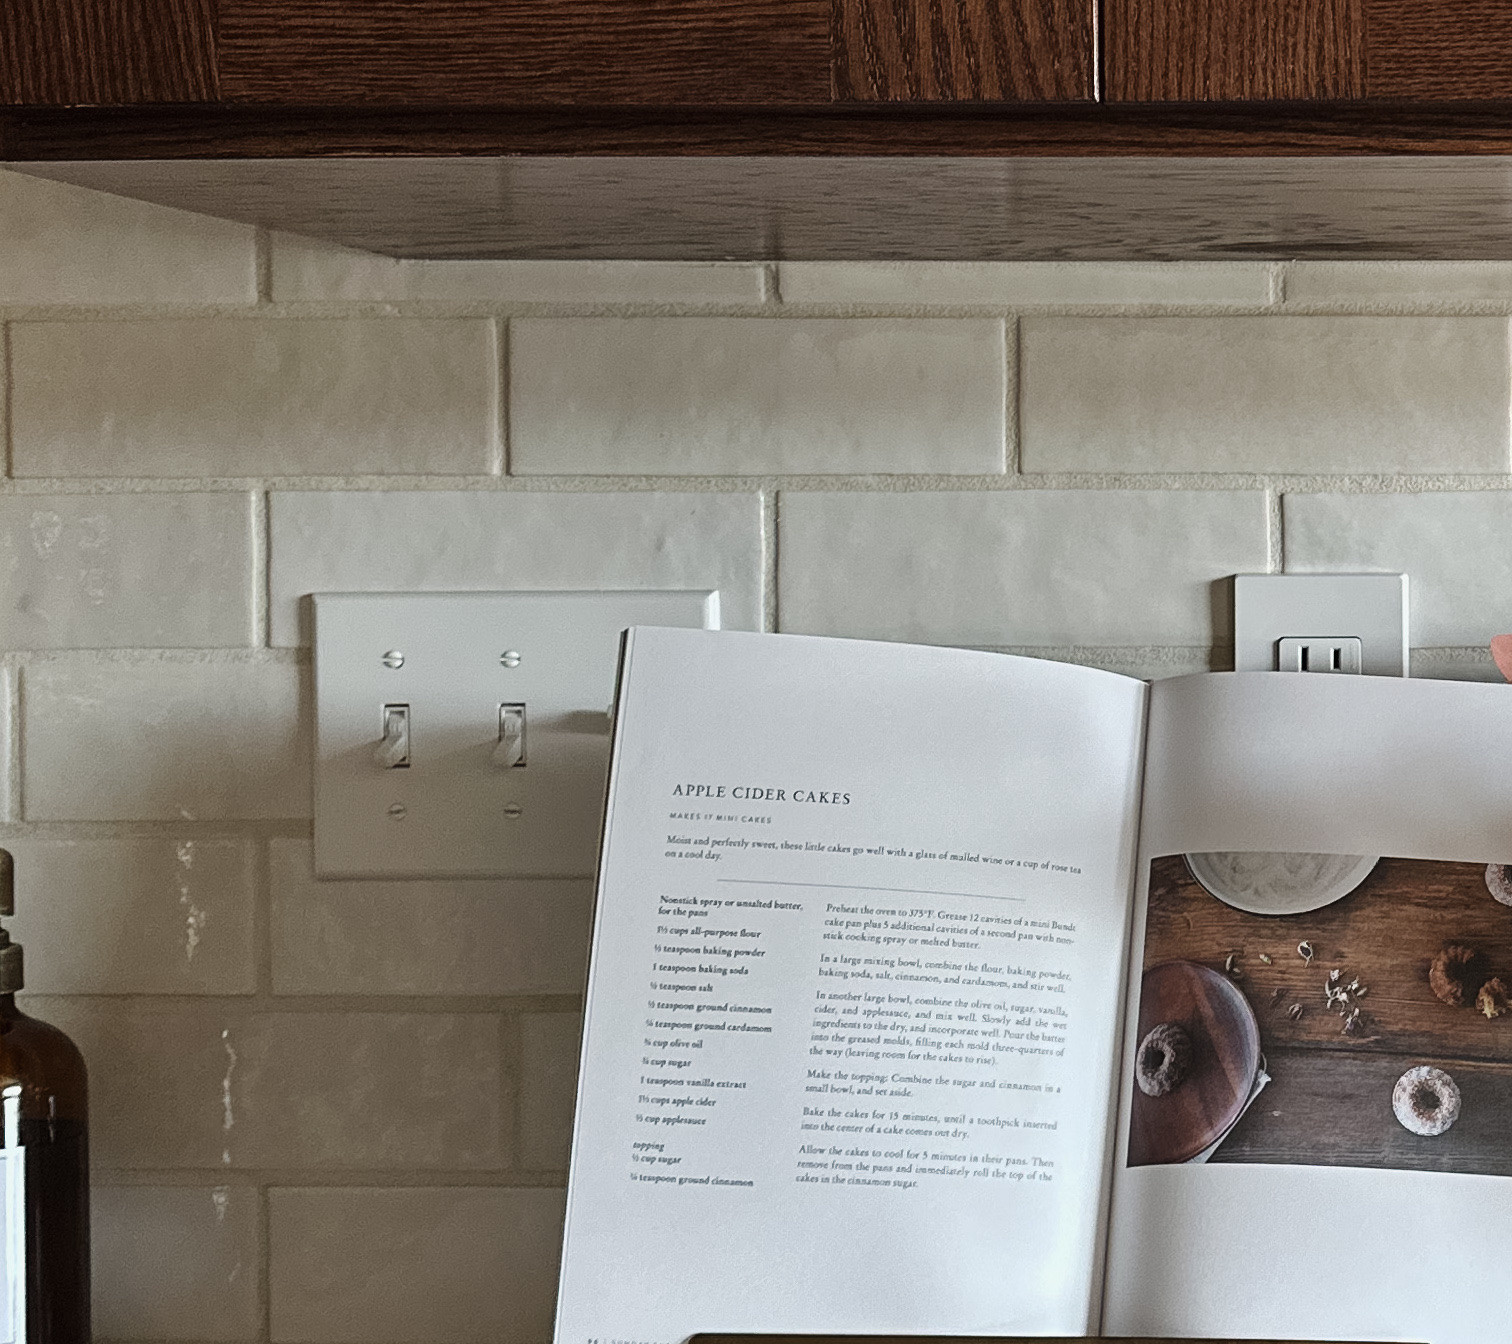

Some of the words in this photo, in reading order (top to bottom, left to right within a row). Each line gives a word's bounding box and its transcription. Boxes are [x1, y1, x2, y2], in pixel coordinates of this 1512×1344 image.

[672, 783, 727, 798] APPLE
[732, 786, 787, 801] CIDER
[792, 789, 851, 805] CAKES
[669, 812, 702, 821] MAKES
[741, 815, 773, 825] CAKES
[667, 835, 691, 845] Moist
[693, 836, 710, 845] and
[711, 837, 750, 849] perfectly
[780, 840, 803, 850] these
[805, 841, 825, 851] little
[827, 843, 851, 853] cakes
[852, 847, 864, 856] go
[866, 846, 885, 855] well
[886, 848, 907, 857] with
[938, 851, 948, 860] of
[950, 853, 980, 863] mulled
[982, 856, 1002, 865] wine
[1023, 862, 1038, 871] cup
[1040, 861, 1051, 870] of
[1070, 865, 1082, 873] tea
[684, 850, 703, 859] cool
[705, 851, 722, 862] day.
[660, 895, 698, 905] Nonstick
[700, 899, 723, 908] spray
[736, 899, 773, 908] unsalted
[658, 906, 671, 915] for
[673, 907, 687, 916] the
[688, 910, 709, 918] pans
[826, 904, 859, 914] Preheat
[860, 906, 874, 915] the
[898, 909, 907, 917] to
[937, 910, 967, 921] Grease
[970, 913, 979, 922] 12
[980, 916, 1012, 925] cavities
[1013, 917, 1023, 926] of
[1030, 920, 1050, 928] mini
[669, 928, 689, 937] cups
[690, 926, 738, 939] all-purpose
[740, 928, 762, 938] flour
[824, 917, 844, 927] cake
[845, 921, 862, 929] pan
[863, 919, 882, 930] plus
[890, 921, 935, 932] additional
[936, 925, 968, 934] cavities
[969, 926, 979, 935] of
[987, 930, 1016, 938] second
[1017, 933, 1033, 941] pan
[1035, 933, 1054, 942] with
[822, 931, 844, 940] stick
[845, 932, 881, 944] cooking
[882, 936, 907, 946] spray
[920, 936, 950, 946] melted
[663, 945, 700, 956] teaspoon
[702, 945, 732, 958] baking
[734, 947, 766, 958] powder
[659, 963, 697, 974] teaspoon
[698, 964, 728, 976] baking
[729, 965, 749, 974] soda
[820, 954, 830, 963] In
[840, 954, 861, 966] large
[864, 957, 895, 968] mixing
[924, 960, 962, 970] combine
[964, 963, 979, 972] the
[1006, 966, 1036, 979] baking
[818, 967, 848, 979] baking
[943, 975, 960, 984] and
[1012, 980, 1028, 989] and
[659, 982, 697, 993] teaspoon
[657, 1001, 694, 1012] teaspoon
[696, 1003, 728, 1013] ground
[729, 1004, 772, 1014] cinnamon
[655, 1019, 692, 1030] teaspoon
[694, 1021, 726, 1031] ground
[727, 1022, 772, 1032] cardamom
[652, 1041, 668, 1049] cup
[669, 1039, 690, 1048] olive
[692, 1040, 703, 1049] oil
[650, 1059, 666, 1068] cup
[668, 1060, 692, 1069] sugar
[646, 1077, 684, 1088] teaspoon
[686, 1078, 715, 1087] vanilla
[716, 1080, 746, 1088] extract
[650, 1098, 670, 1107] cups
[672, 1096, 693, 1107] apple
[695, 1097, 716, 1106] cider
[644, 1117, 660, 1125] cup
[662, 1115, 706, 1126] applesauce
[632, 1141, 665, 1152] topping
[640, 1156, 656, 1165] cup
[658, 1157, 682, 1166] sugar
[799, 1145, 826, 1154] Allow
[828, 1146, 843, 1155] the
[845, 1147, 869, 1156] cakes
[872, 1149, 881, 1157] to
[884, 1149, 904, 1158] cool
[906, 1150, 919, 1159] for
[931, 1152, 967, 1162] minutes
[969, 1154, 979, 1162] in
[981, 1154, 1003, 1164] their
[639, 1173, 676, 1184] teaspoon
[678, 1175, 710, 1185] ground
[711, 1177, 753, 1186] cinnamon
[795, 1173, 819, 1183] cakes
[821, 1175, 830, 1183] in
[832, 1175, 845, 1184] the
